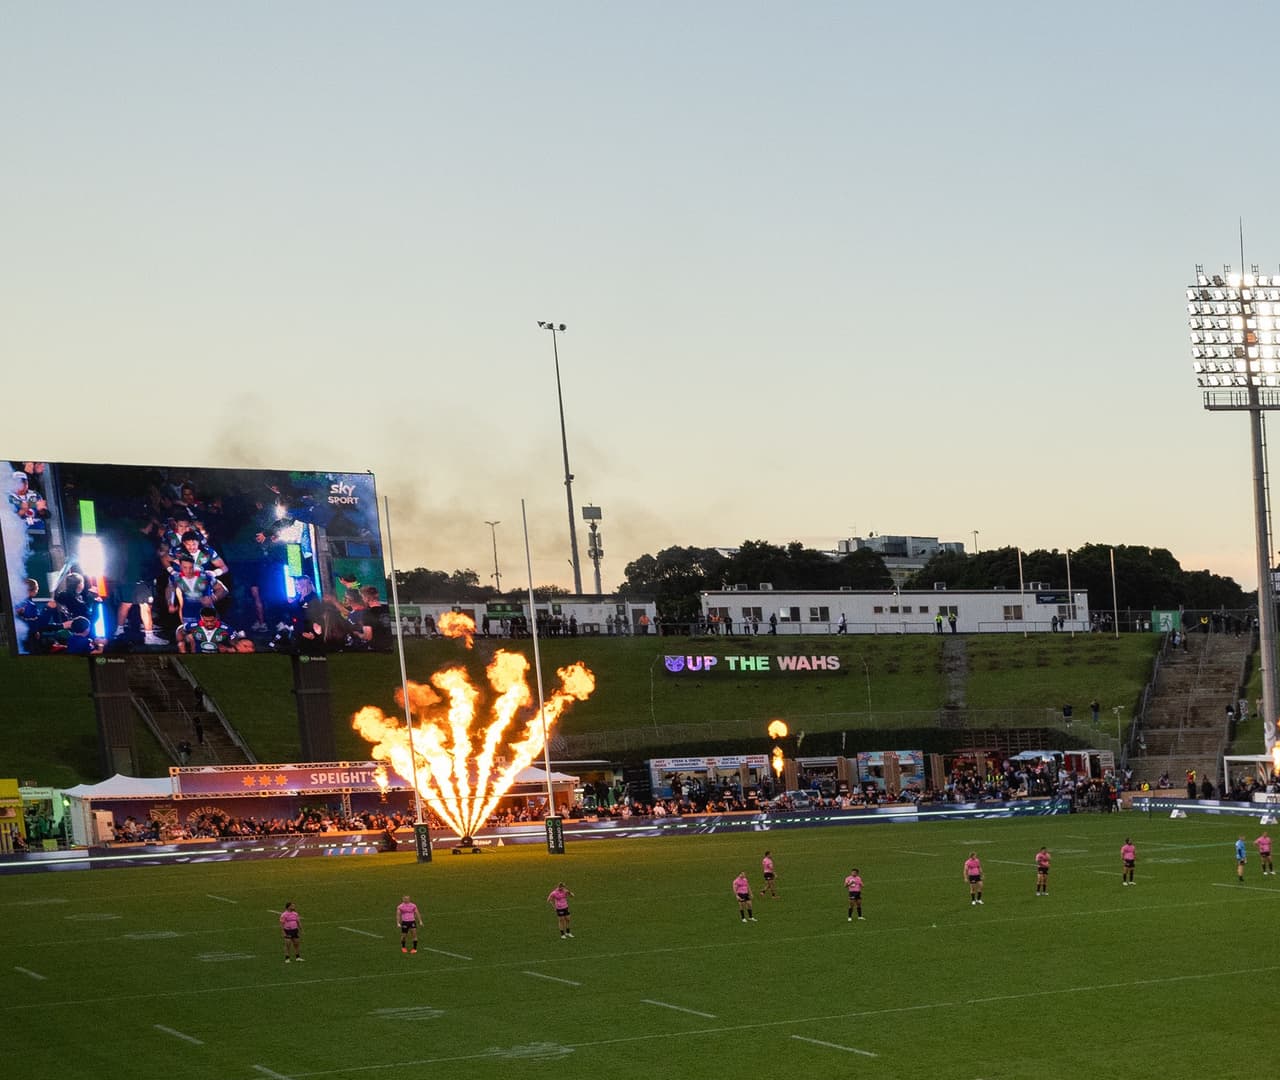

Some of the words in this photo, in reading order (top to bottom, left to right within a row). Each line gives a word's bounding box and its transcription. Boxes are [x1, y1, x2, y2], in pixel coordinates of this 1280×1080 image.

[330, 481, 356, 496] sky
[327, 496, 359, 504] SPORT
[686, 656, 717, 671] UP
[725, 656, 770, 670] THE
[777, 655, 840, 670] WAHS
